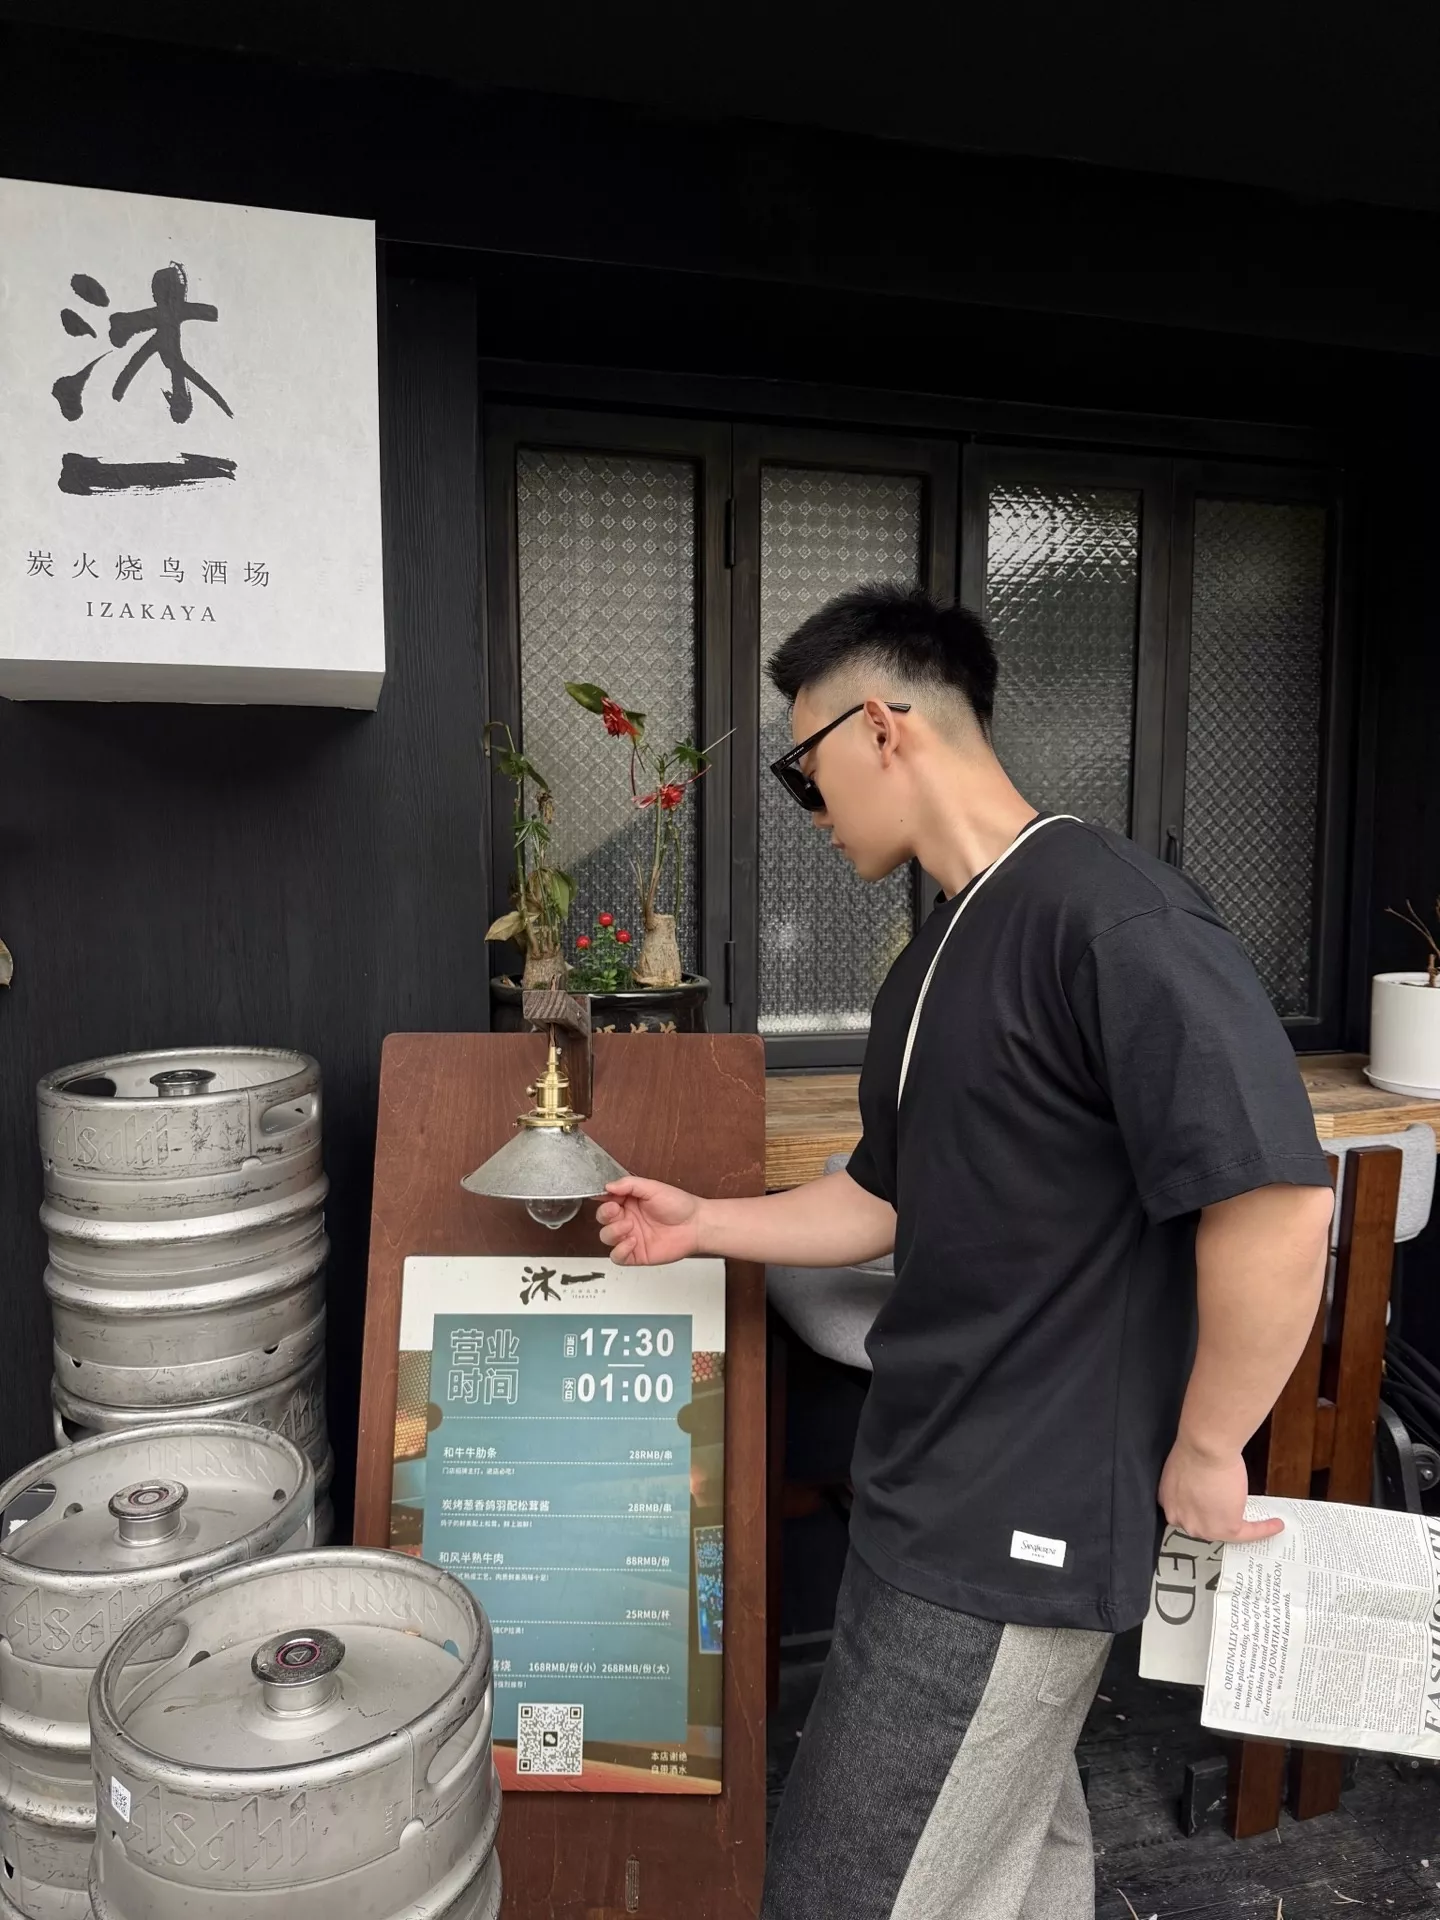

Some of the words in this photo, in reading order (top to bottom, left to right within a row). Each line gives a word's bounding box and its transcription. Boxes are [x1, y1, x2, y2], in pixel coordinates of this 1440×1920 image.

[26, 550, 271, 588] 炭火烧鸟酒场
[86, 601, 217, 624] IZAKAYA
[451, 1328, 520, 1366] 营业
[580, 1327, 675, 1357] 17:30
[448, 1367, 520, 1405] 时间
[577, 1373, 674, 1403] 01:00
[443, 1446, 498, 1460] 和牛牛肋条
[629, 1450, 674, 1461] 28RMB/串
[627, 1502, 673, 1514] 28RMB/串
[438, 1551, 504, 1565] 和风半熟牛肉
[625, 1555, 671, 1567] 88RMB/份
[1254, 1563, 1264, 1596] Spanish
[1263, 1573, 1272, 1604] creative
[1272, 1561, 1283, 1615] ANDERSON
[1230, 1572, 1244, 1630] SCHEDULED
[1241, 1575, 1254, 1618] fall/winter
[1283, 1592, 1291, 1620] month.
[625, 1609, 671, 1621] 25RMB/杯
[1252, 1609, 1264, 1620] of
[1263, 1605, 1271, 1619] the
[1241, 1618, 1250, 1632] the
[1252, 1621, 1260, 1642] show
[1263, 1620, 1271, 1644] under
[1281, 1621, 1290, 1636] last
[1239, 1634, 1250, 1658] today,
[1268, 1615, 1281, 1671] JONATHAN
[1224, 1629, 1239, 1690] ORIGINALLY
[1249, 1643, 1259, 1673] runway
[1259, 1645, 1268, 1670] brand
[1278, 1637, 1289, 1674] cancelled
[1236, 1660, 1247, 1682] place
[1265, 1668, 1276, 1679] of
[1276, 1675, 1284, 1690] was
[1234, 1683, 1244, 1700] take
[1254, 1672, 1265, 1703] fashion
[1262, 1680, 1273, 1716] direction
[1233, 1701, 1241, 1710] to
